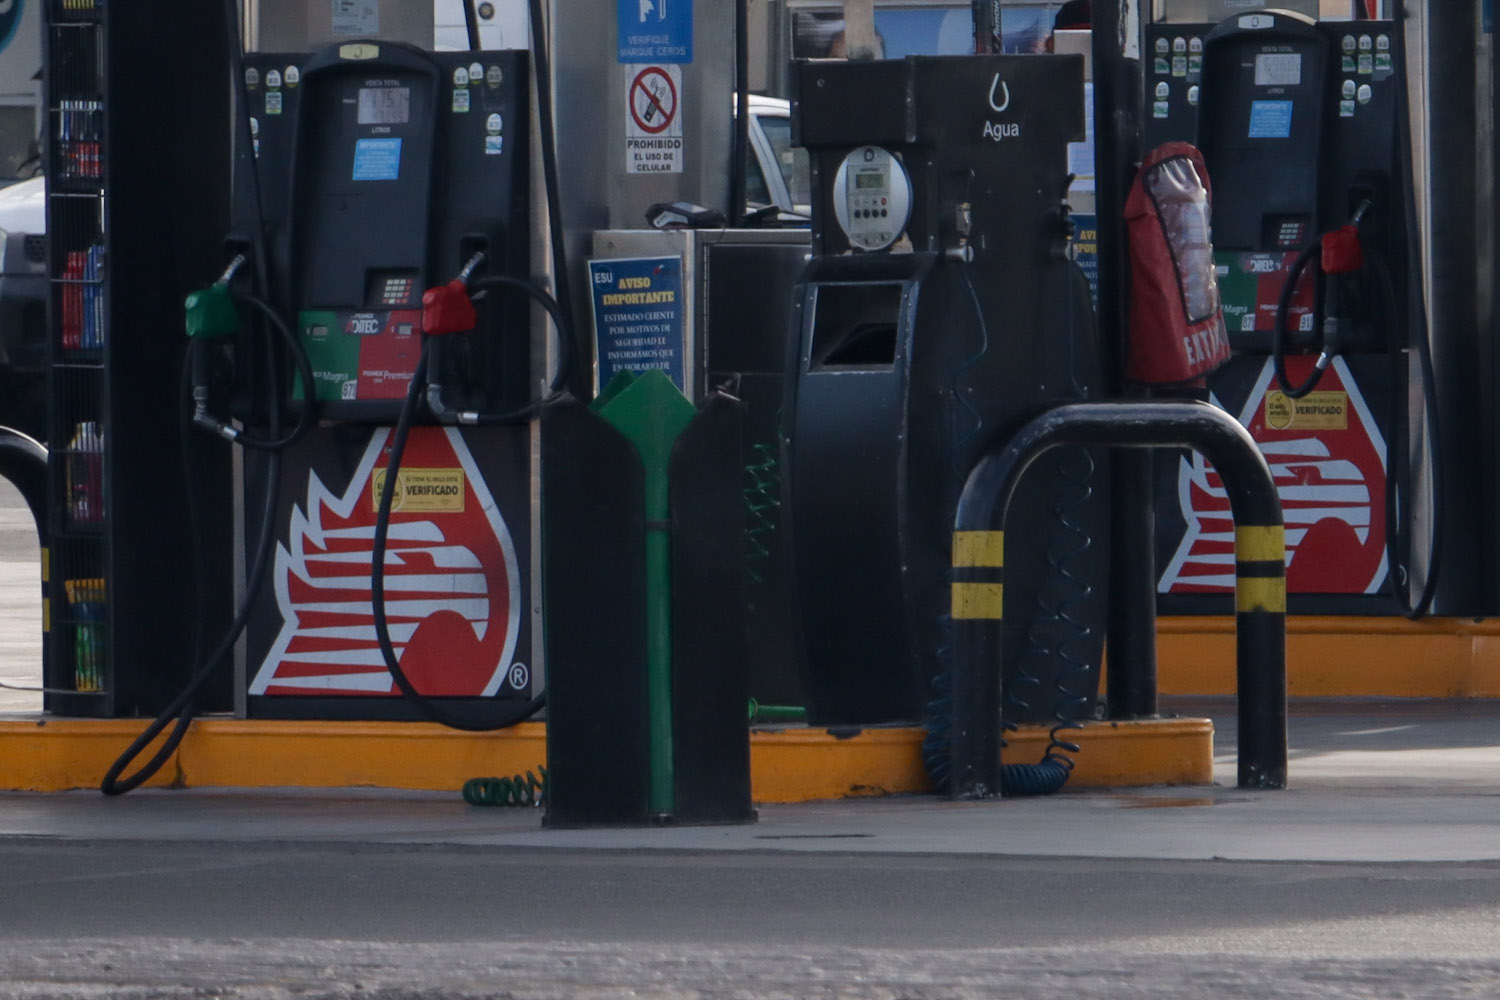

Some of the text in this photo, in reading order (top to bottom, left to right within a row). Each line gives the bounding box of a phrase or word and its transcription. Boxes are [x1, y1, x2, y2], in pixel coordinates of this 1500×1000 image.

[627, 35, 669, 45] VERIFIQUE
[983, 120, 1020, 142] Agua
[627, 139, 681, 149] PROHIBIDO
[634, 152, 673, 161] EL USO DE
[637, 163, 672, 172] CELULAR
[594, 272, 613, 284] ESU
[618, 277, 651, 289] AVISO
[602, 291, 675, 306] IMPORTANTE
[604, 311, 675, 322] ESTIMADO CLIENTE
[609, 324, 671, 335] POR MOTIVOS DE
[615, 338, 657, 347] SEGURIDAD
[608, 349, 658, 360] INFORMAMOS
[1295, 406, 1342, 415] VERIFICADO
[406, 485, 459, 495] VERIFICADO
